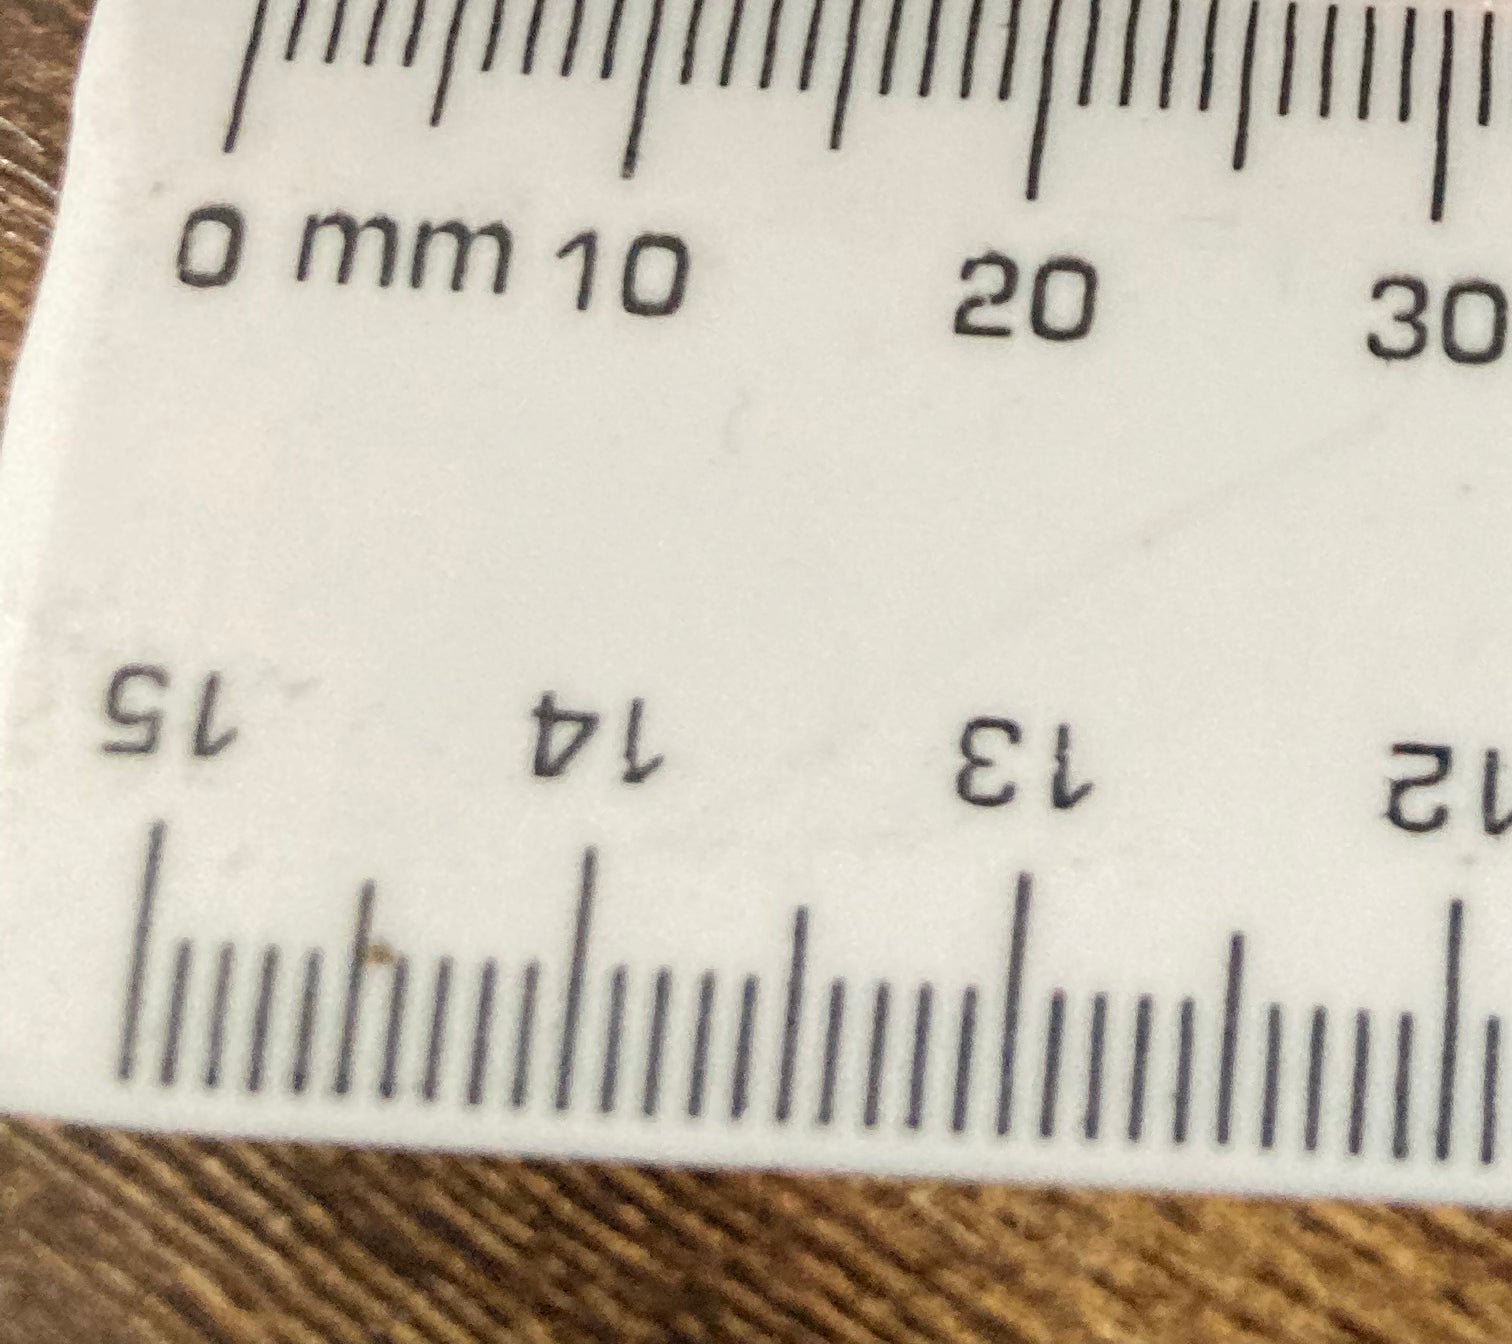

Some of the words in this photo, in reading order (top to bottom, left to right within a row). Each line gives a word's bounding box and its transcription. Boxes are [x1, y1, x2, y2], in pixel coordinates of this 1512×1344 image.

[174, 201, 248, 291] 0
[294, 207, 515, 297] mm
[554, 227, 693, 320] 10
[950, 248, 1101, 345] 20
[1364, 272, 1511, 367] 30
[98, 661, 240, 763] 15
[529, 689, 666, 787] 14
[953, 714, 1097, 814] 13
